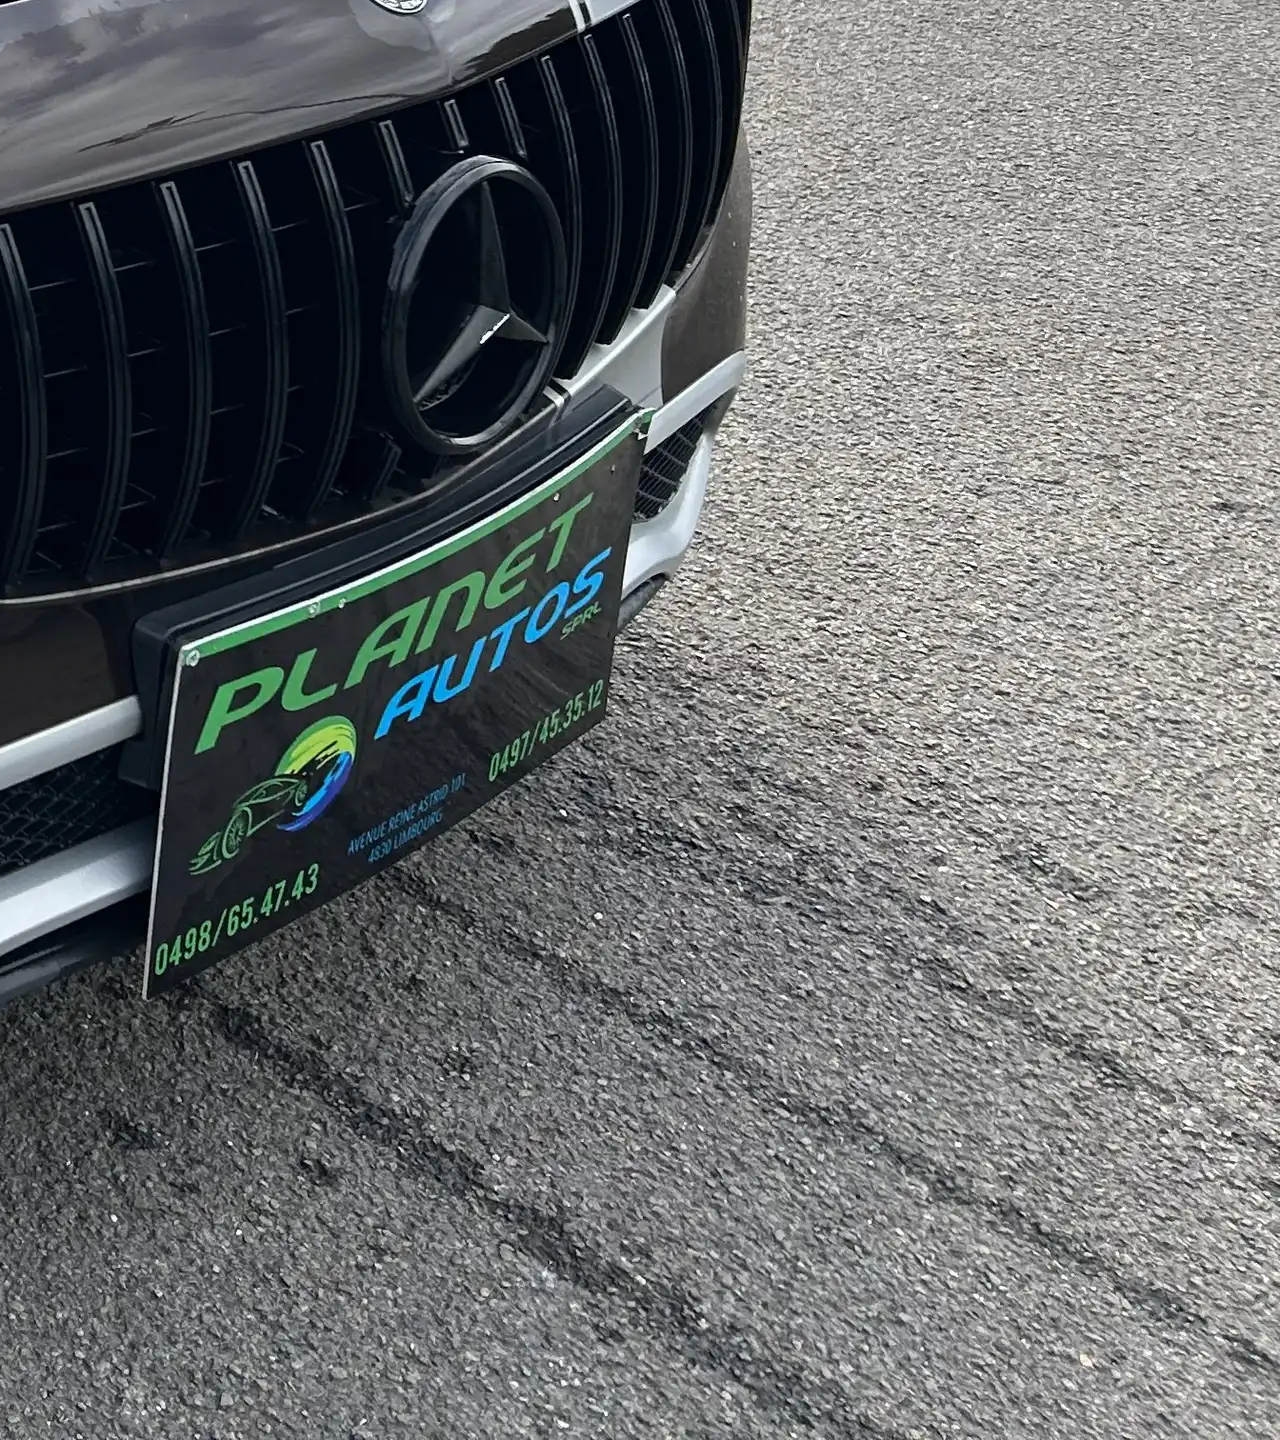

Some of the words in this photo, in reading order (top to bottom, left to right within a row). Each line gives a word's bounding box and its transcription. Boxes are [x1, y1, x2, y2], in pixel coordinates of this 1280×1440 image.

[194, 491, 593, 755] PLANET
[374, 547, 612, 740] AUTOS
[560, 601, 602, 640] SPRL
[488, 679, 603, 782] 0497/45.35.12
[347, 822, 388, 857] AVENUE
[388, 803, 417, 832] REINE
[154, 863, 319, 976] 0498/65.47.43
